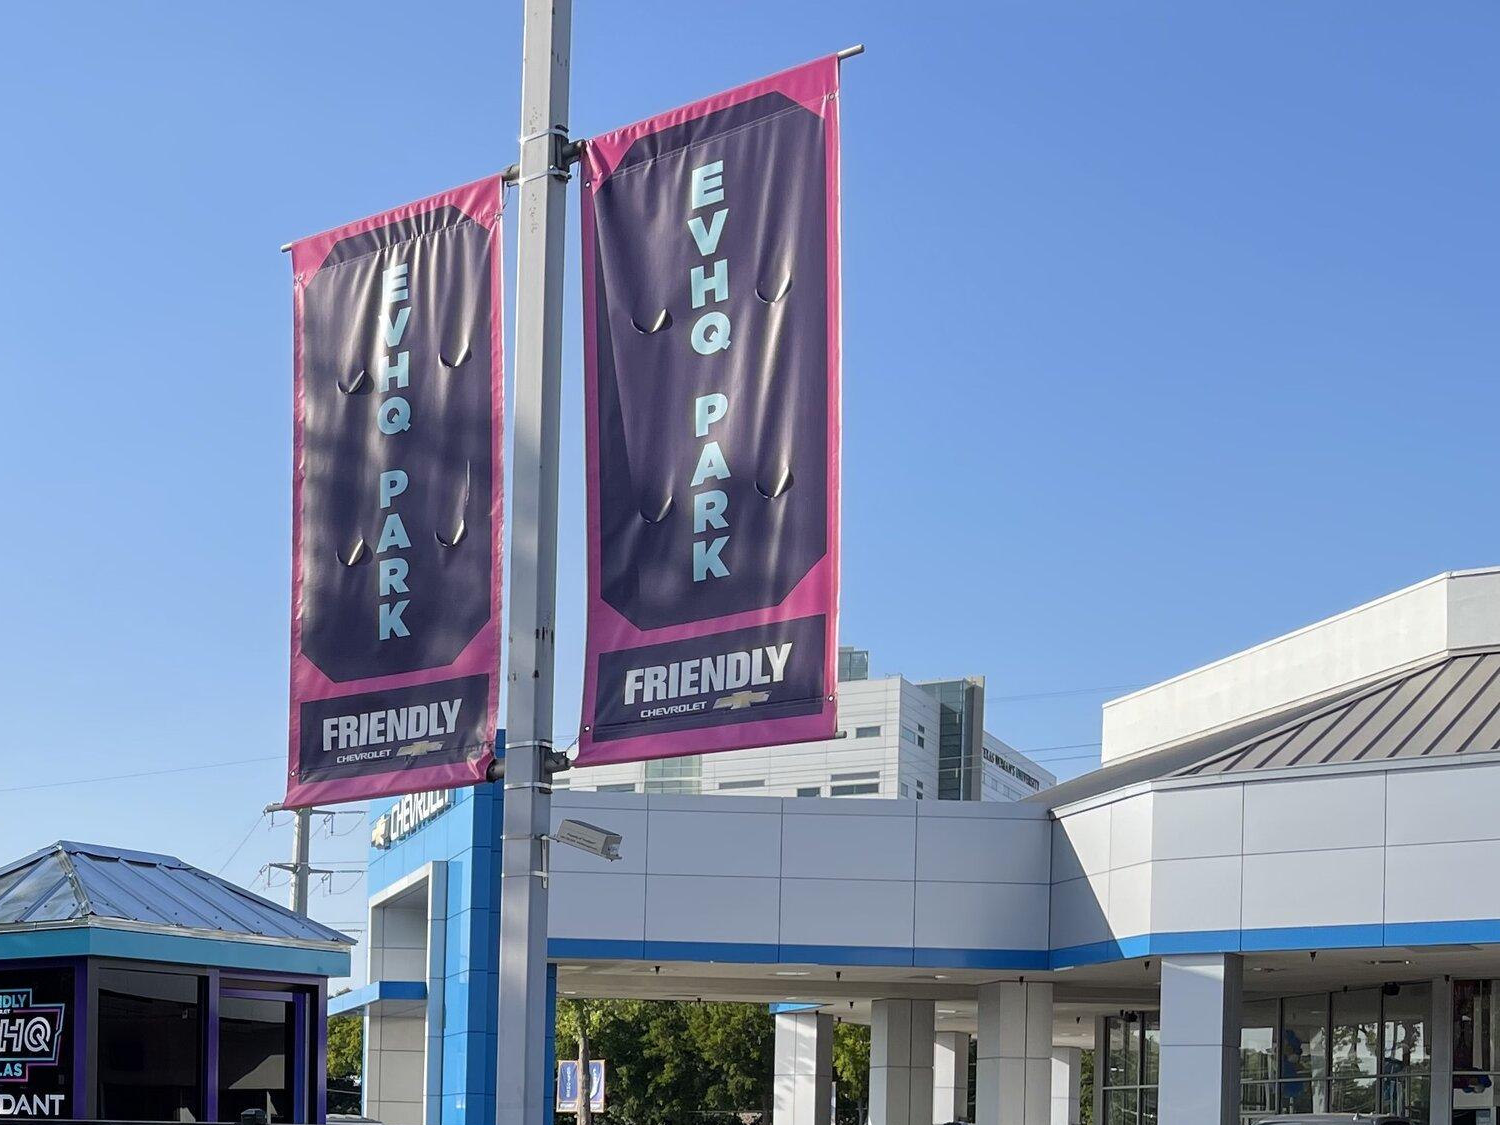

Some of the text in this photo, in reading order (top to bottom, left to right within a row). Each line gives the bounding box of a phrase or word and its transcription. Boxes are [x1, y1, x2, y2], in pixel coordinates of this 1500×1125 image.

[687, 159, 732, 583] EVHQ PARK
[376, 262, 412, 641] EVHQ PARK
[624, 641, 793, 706] FRIENDLY
[322, 698, 463, 752] FRIENDLY
[640, 701, 707, 718] CHEVROLET
[336, 749, 392, 764] CHEVROLET
